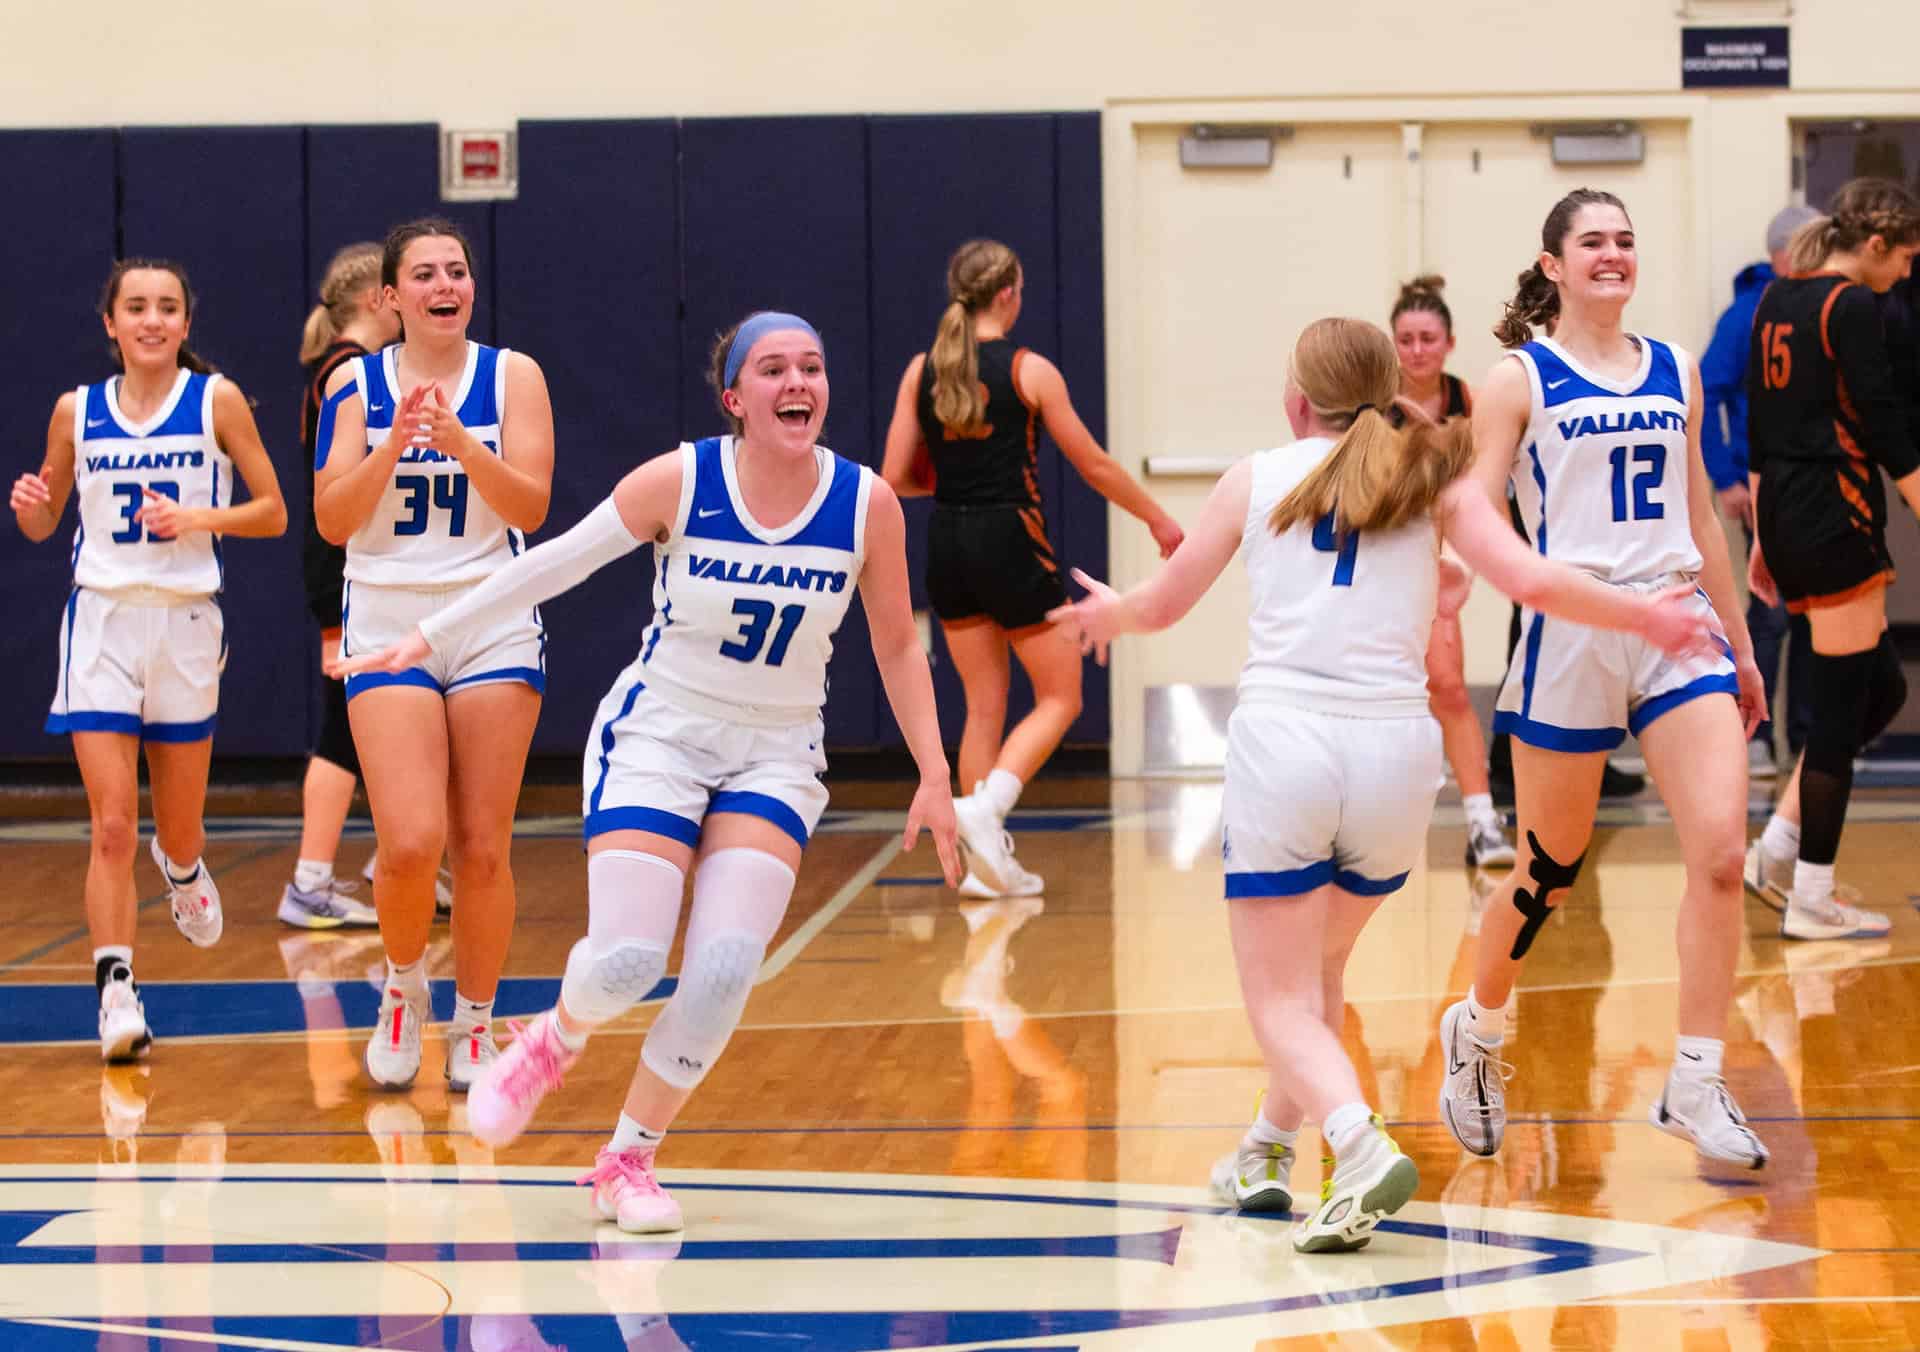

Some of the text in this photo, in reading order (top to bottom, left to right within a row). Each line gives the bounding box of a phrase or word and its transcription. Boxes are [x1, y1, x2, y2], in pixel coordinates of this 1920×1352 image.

[1761, 321, 1793, 391] 15
[86, 450, 204, 473] VALIANTS
[1609, 444, 1667, 523] 12
[394, 473, 469, 538] 34
[689, 554, 848, 594] VALIANTS
[719, 598, 807, 667] 31
